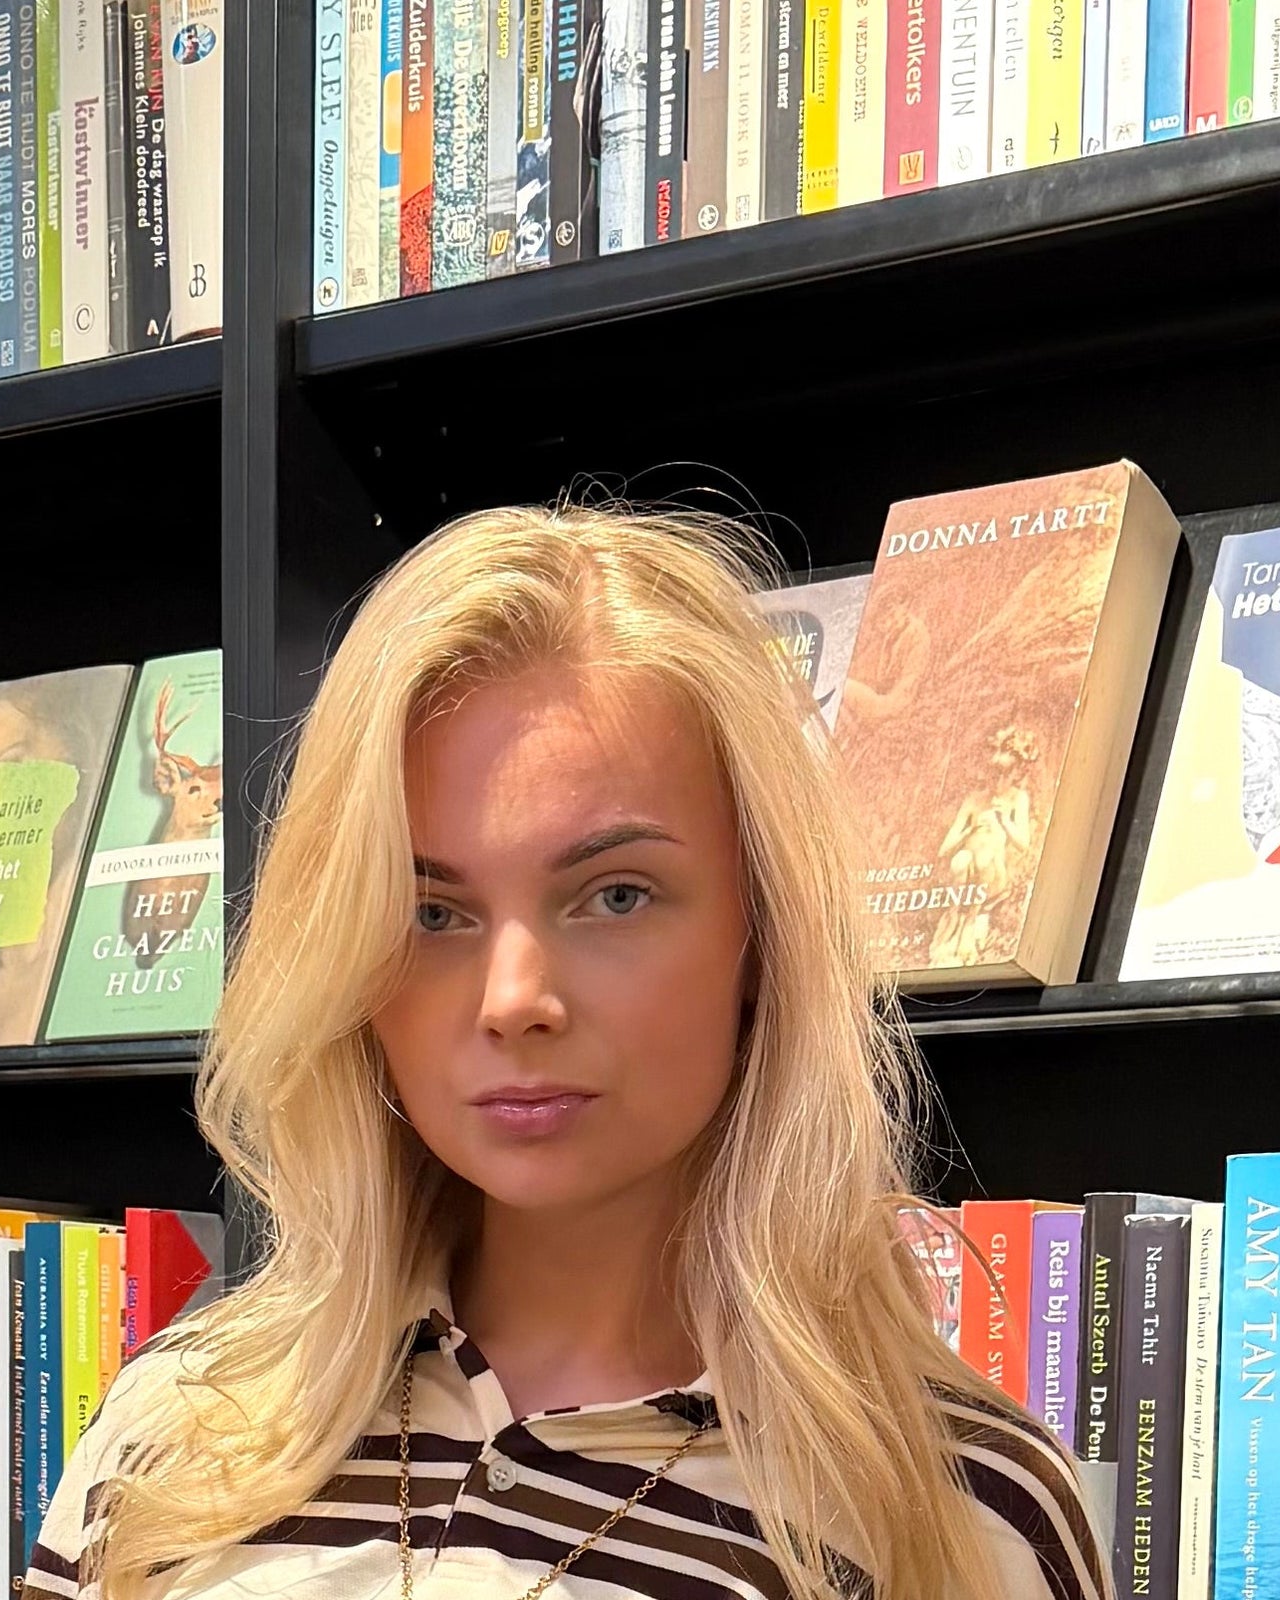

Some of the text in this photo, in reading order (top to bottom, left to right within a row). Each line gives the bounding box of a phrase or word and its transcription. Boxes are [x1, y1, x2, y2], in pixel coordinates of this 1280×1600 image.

[319, 139, 338, 265] Ooggetuigen
[885, 500, 1113, 558] DONNA TARTT
[133, 889, 198, 918] HET
[92, 927, 219, 960] GLAZEN
[104, 966, 184, 996] HUIS
[1241, 1197, 1278, 1403] AMY TAN
[1133, 1399, 1156, 1595] EENZAAM HEDEN
